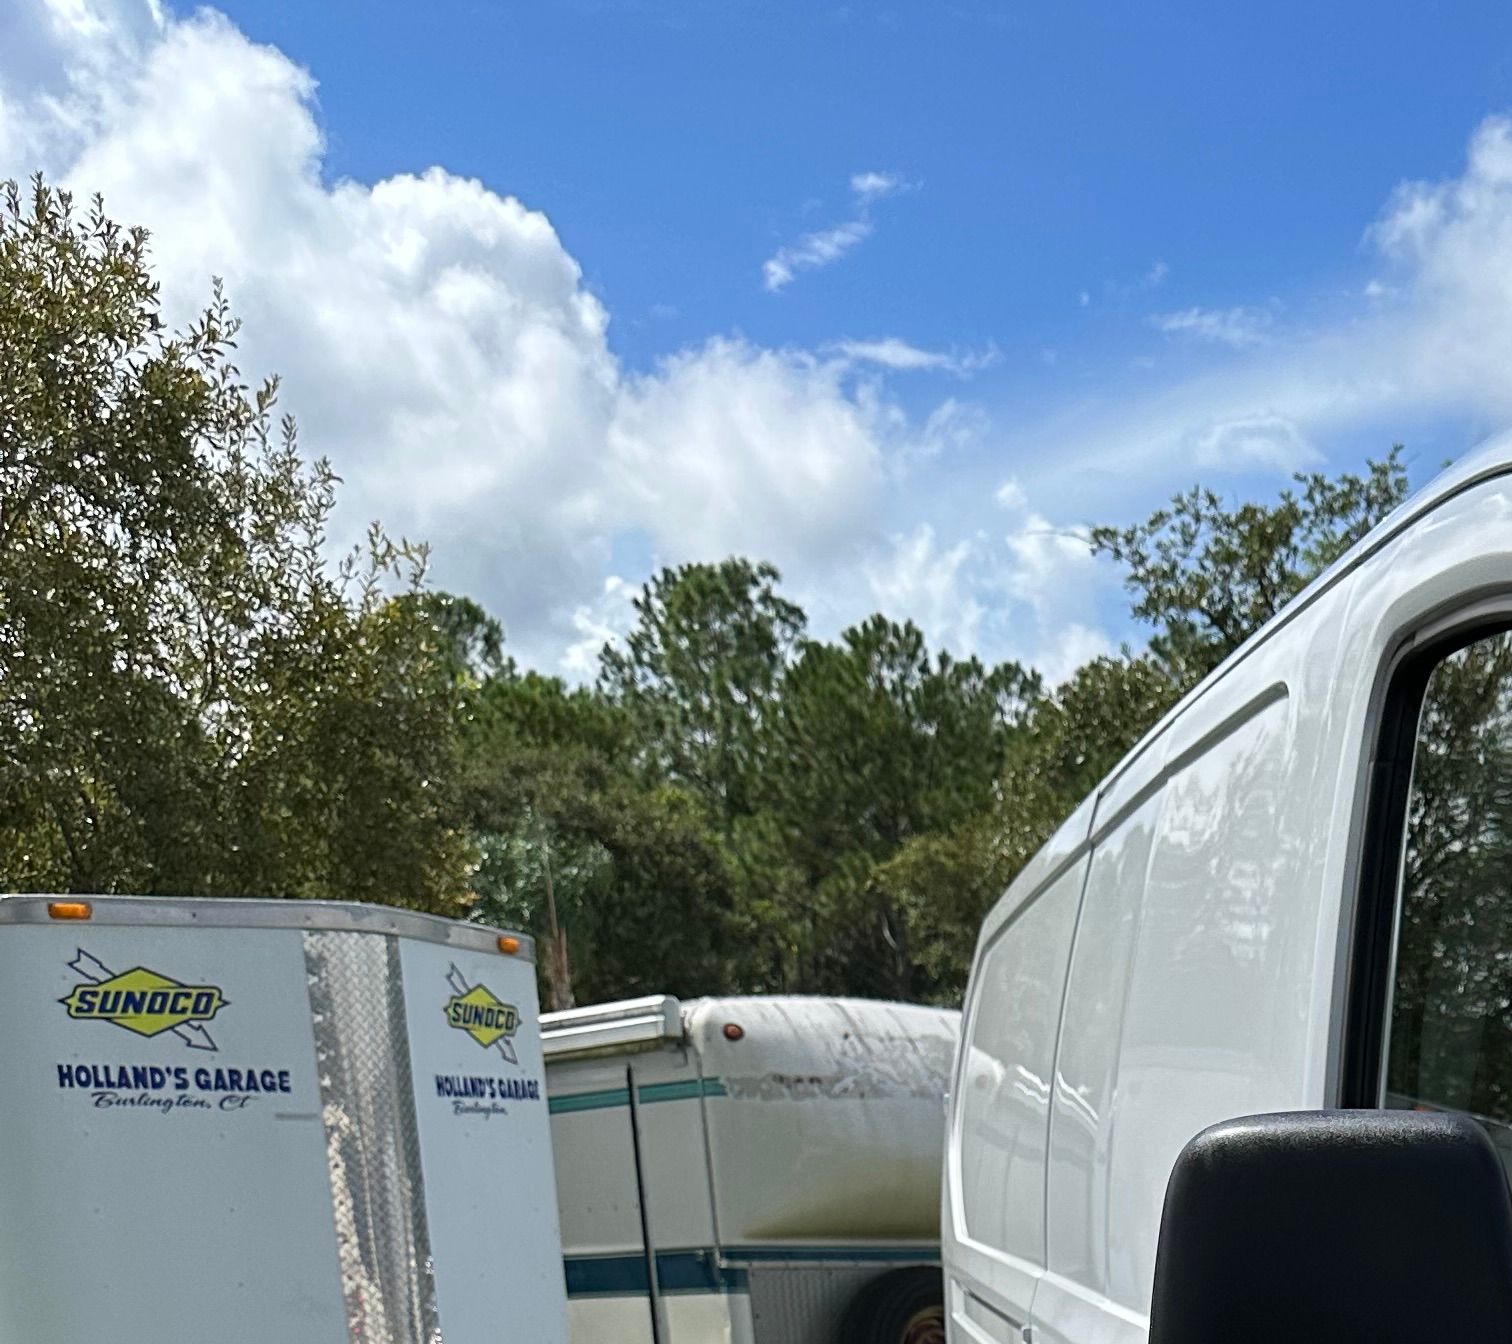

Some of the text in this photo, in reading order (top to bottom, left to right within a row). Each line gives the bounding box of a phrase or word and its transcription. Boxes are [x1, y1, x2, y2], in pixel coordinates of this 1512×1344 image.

[75, 990, 216, 1016] SUNOCO
[451, 1003, 516, 1031] SUNOCO
[57, 1064, 292, 1093] HOLLAND'S GARAGE
[435, 1074, 540, 1101] HOLLAND'S GARAGE
